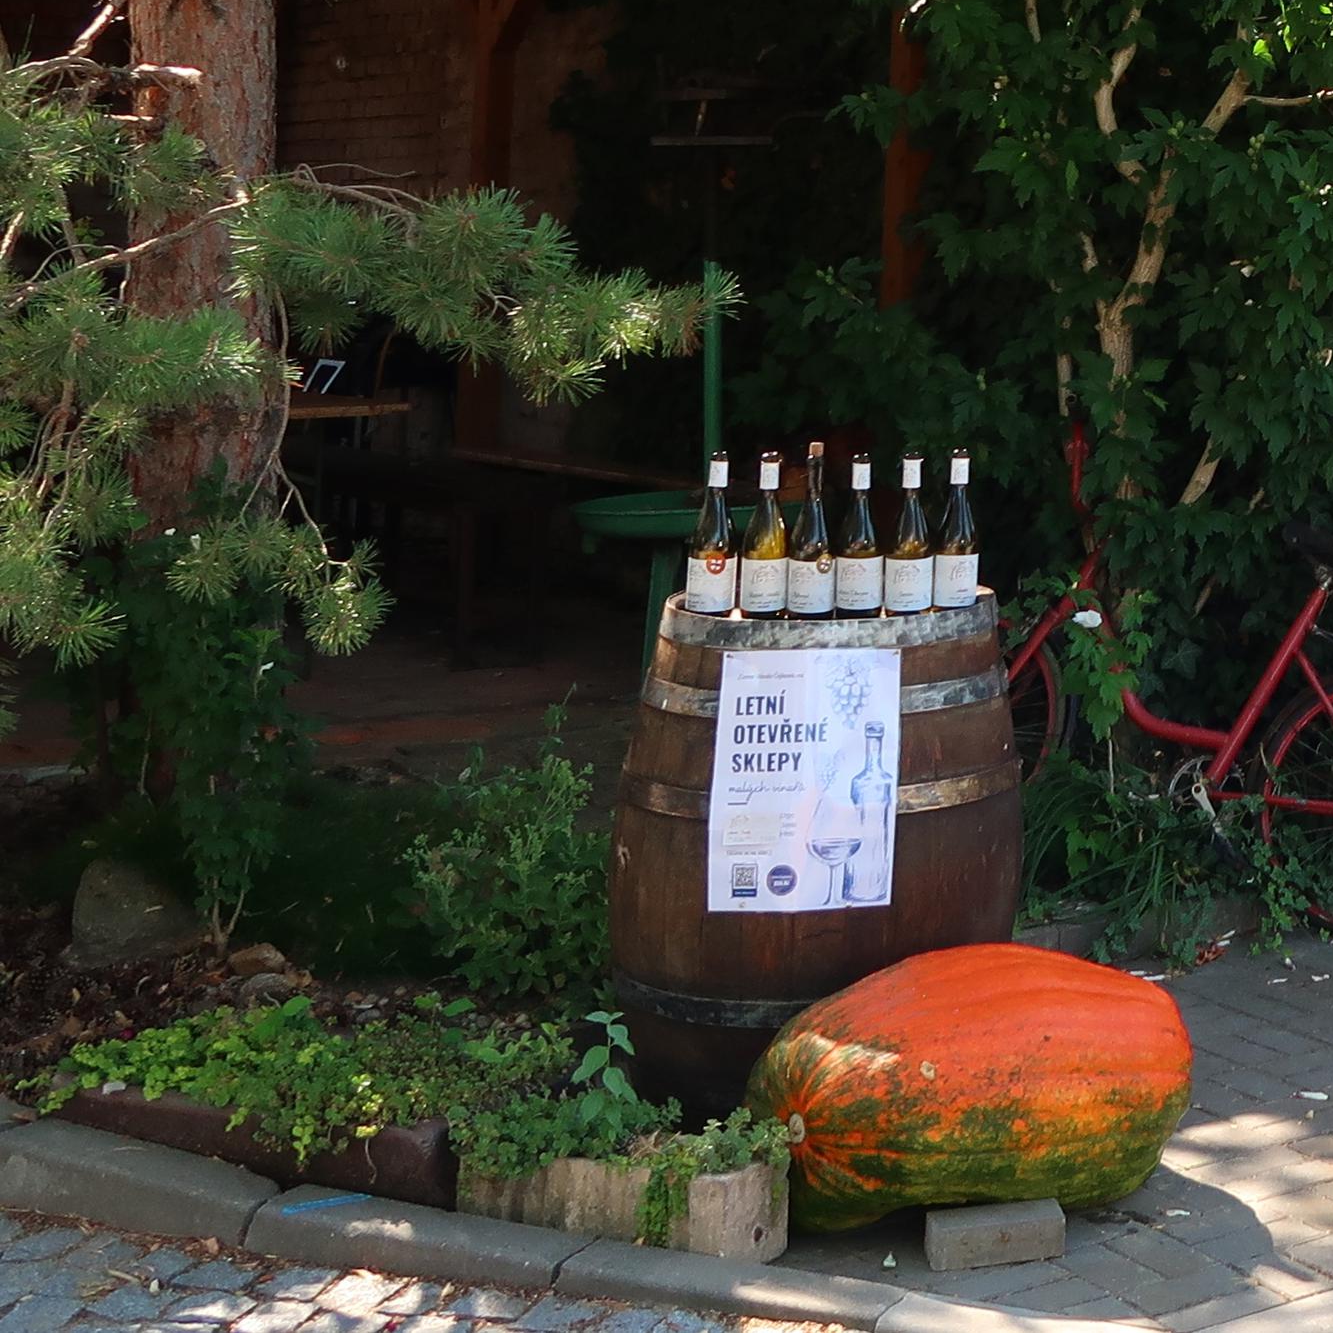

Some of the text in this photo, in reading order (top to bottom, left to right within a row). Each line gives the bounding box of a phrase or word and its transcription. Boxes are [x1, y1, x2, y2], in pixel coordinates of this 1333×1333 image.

[735, 689, 786, 716] LETNÍ
[733, 717, 828, 744] OTEVŘENÉ
[732, 752, 802, 773] SKLEPY
